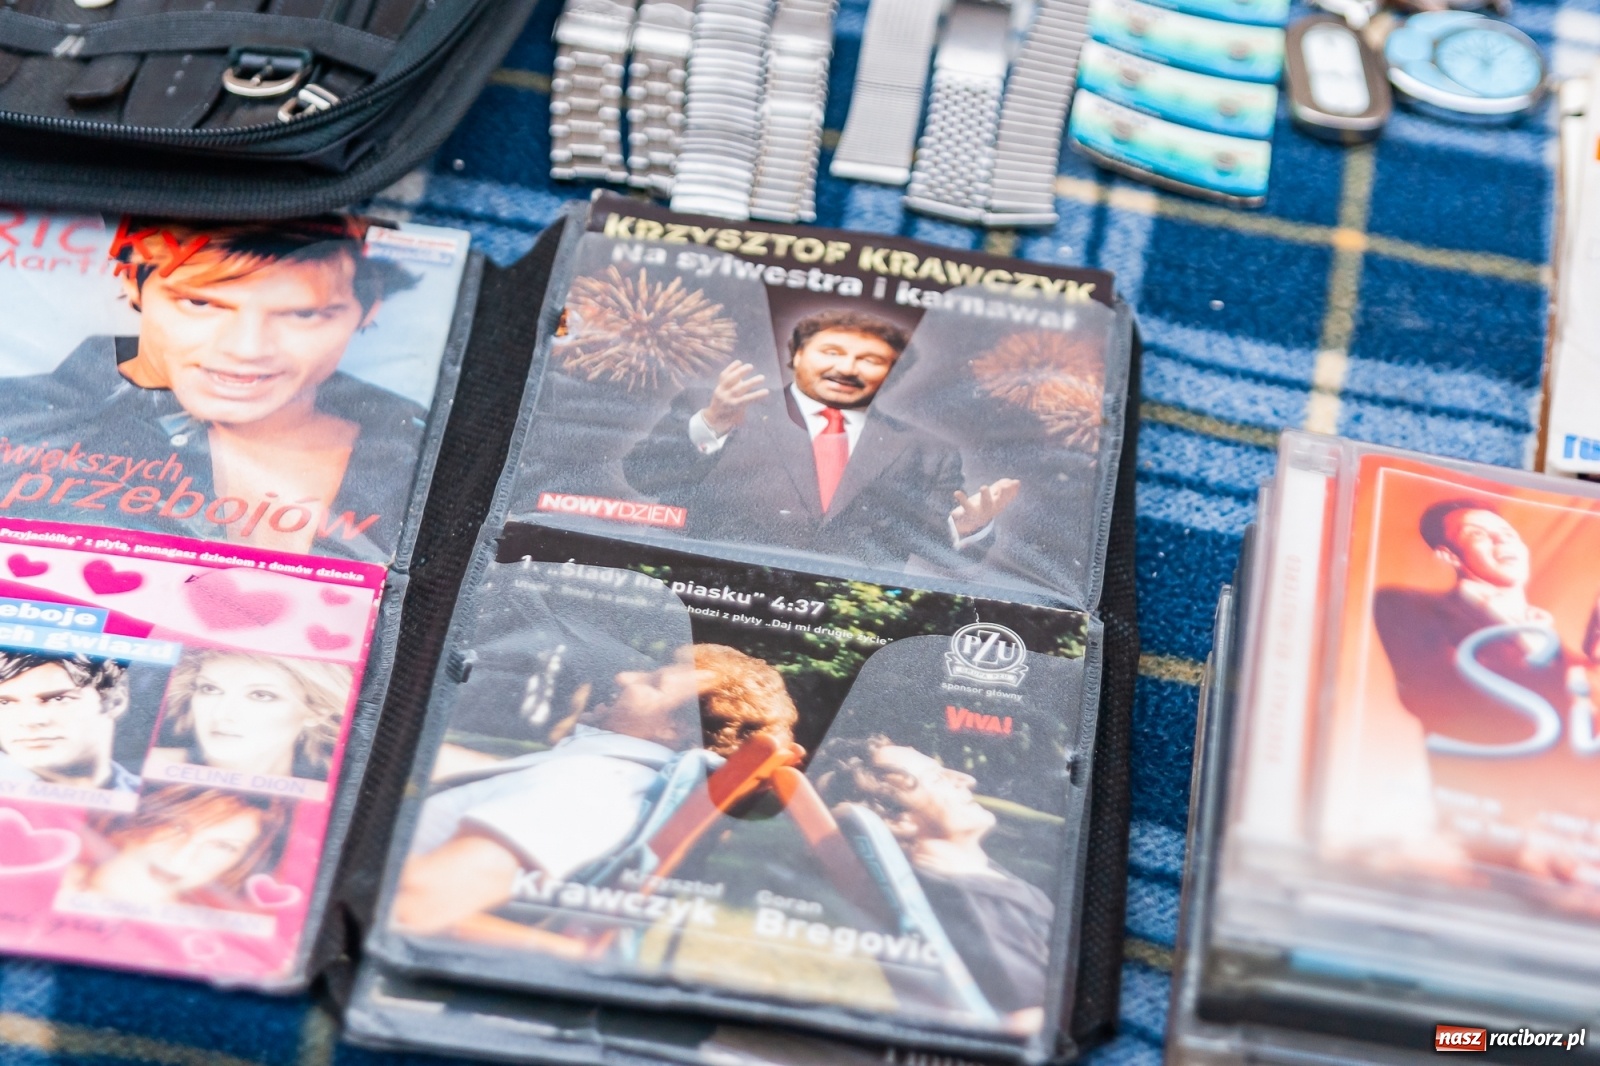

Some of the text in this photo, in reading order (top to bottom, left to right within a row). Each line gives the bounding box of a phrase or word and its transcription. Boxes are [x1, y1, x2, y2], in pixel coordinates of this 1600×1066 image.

[603, 212, 1097, 303] KRZYSZTOF KRAWCZYK
[611, 242, 667, 266] Na
[676, 251, 863, 297] sylwestra
[872, 276, 888, 299] i
[0, 471, 382, 540] przebojów
[85, 538, 93, 546] z
[134, 544, 197, 560] pomagasz
[200, 552, 255, 568] dzieciom
[316, 567, 365, 582] dziecka
[635, 574, 664, 590] na
[770, 598, 825, 616] 4:37
[723, 611, 730, 619] z
[732, 612, 762, 627] płyty
[795, 622, 811, 633] mi
[814, 625, 853, 640] drugie
[963, 629, 1016, 665] PZU
[941, 681, 1023, 702] sponsor główny
[165, 764, 306, 794] CELINE DION
[510, 867, 718, 928] Krawczyk
